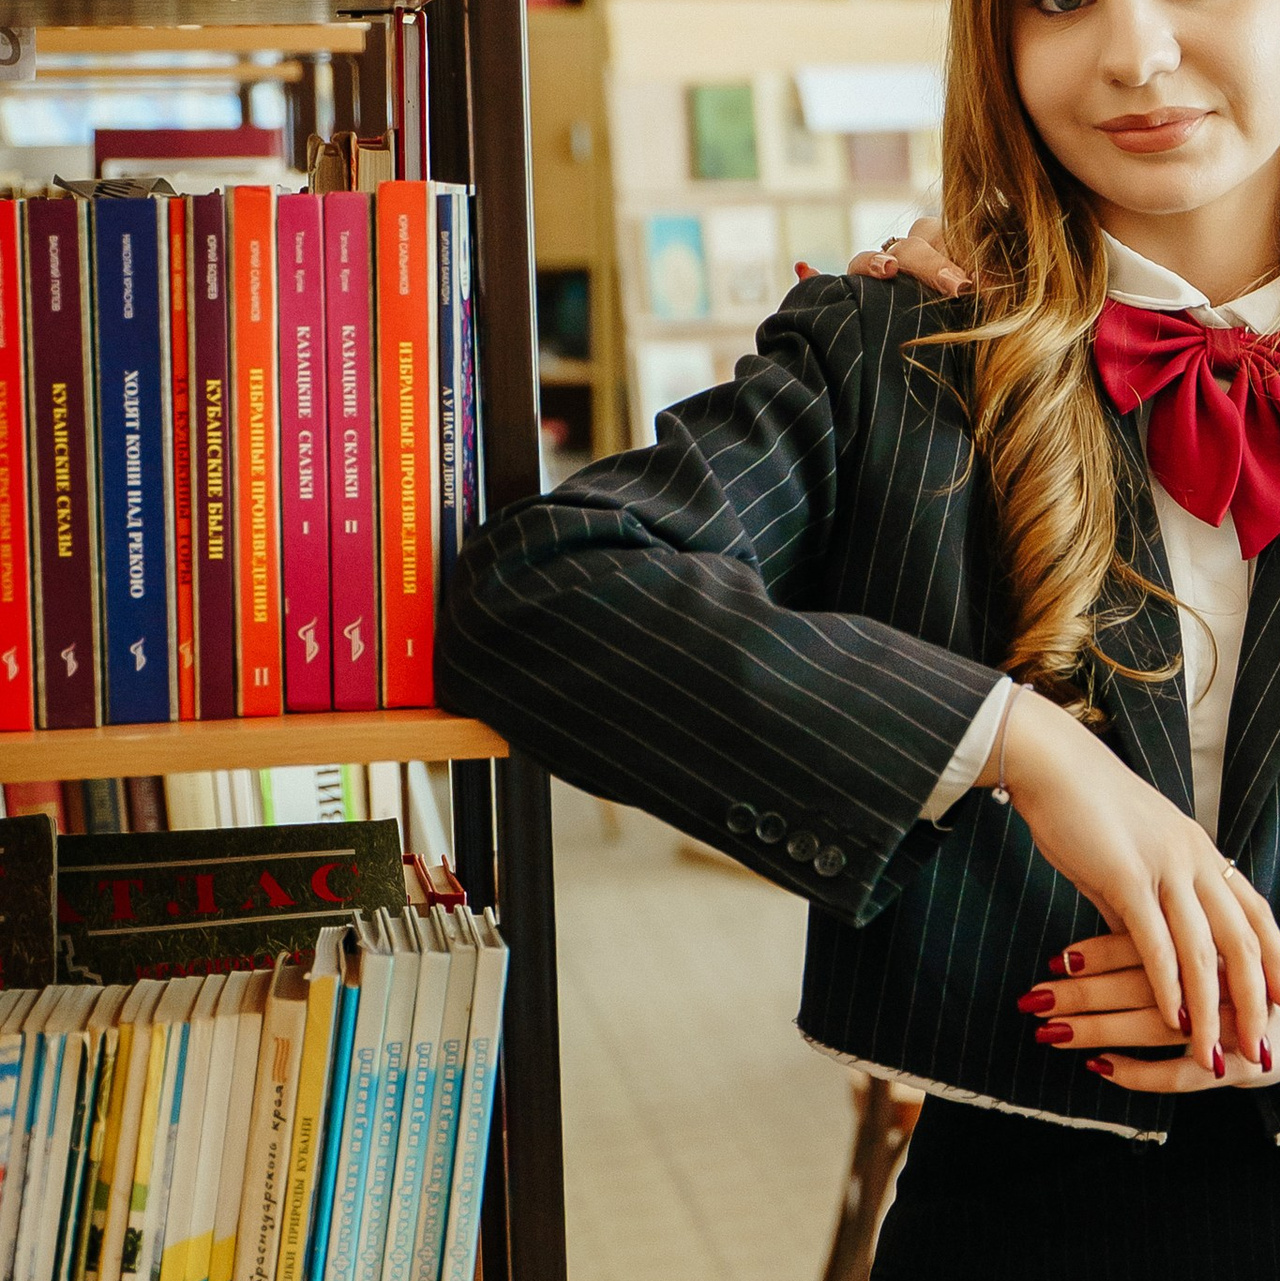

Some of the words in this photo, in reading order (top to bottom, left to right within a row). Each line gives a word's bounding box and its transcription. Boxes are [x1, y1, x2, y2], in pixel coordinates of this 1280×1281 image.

[123, 370, 140, 430] ХОДЯТ
[296, 326, 312, 418] КАЗАЦКИЕ
[341, 325, 358, 418] КАЗАЦКИЕ
[398, 341, 414, 449] ИЗБРАННЫЕ
[442, 386, 452, 399] А
[442, 400, 453, 410] У
[52, 382, 71, 492] КУБАНСКИЕ
[125, 434, 141, 486] КОНИ
[206, 379, 222, 497] КУБАНСКИЕ
[249, 368, 265, 477] ИЗБРАННЫЕ
[443, 412, 453, 440] НАС
[443, 443, 453, 462] ВО
[298, 430, 313, 499] СКАЗКИ
[343, 430, 359, 499] СКАЗКИ
[442, 465, 454, 509] ДВОРЕ
[56, 495, 73, 558] СКАЗЫ
[126, 491, 143, 529] НАД
[208, 502, 223, 560] БЫЛИ
[400, 453, 417, 595] ПРОИЗВЕДЕНИЯ
[128, 531, 144, 599] РЕКОЮ
[252, 482, 268, 623] ПРОИЗВЕДЕНИЯ
[267, 1083, 286, 1131] края
[347, 1046, 375, 1154] названий
[376, 1041, 403, 1147] названий
[404, 1041, 432, 1147] названий
[433, 1038, 460, 1144] названий
[464, 1037, 491, 1143] названий
[286, 1179, 306, 1246] ПРИРОДЫ
[296, 1117, 313, 1173] КУБАНИ
